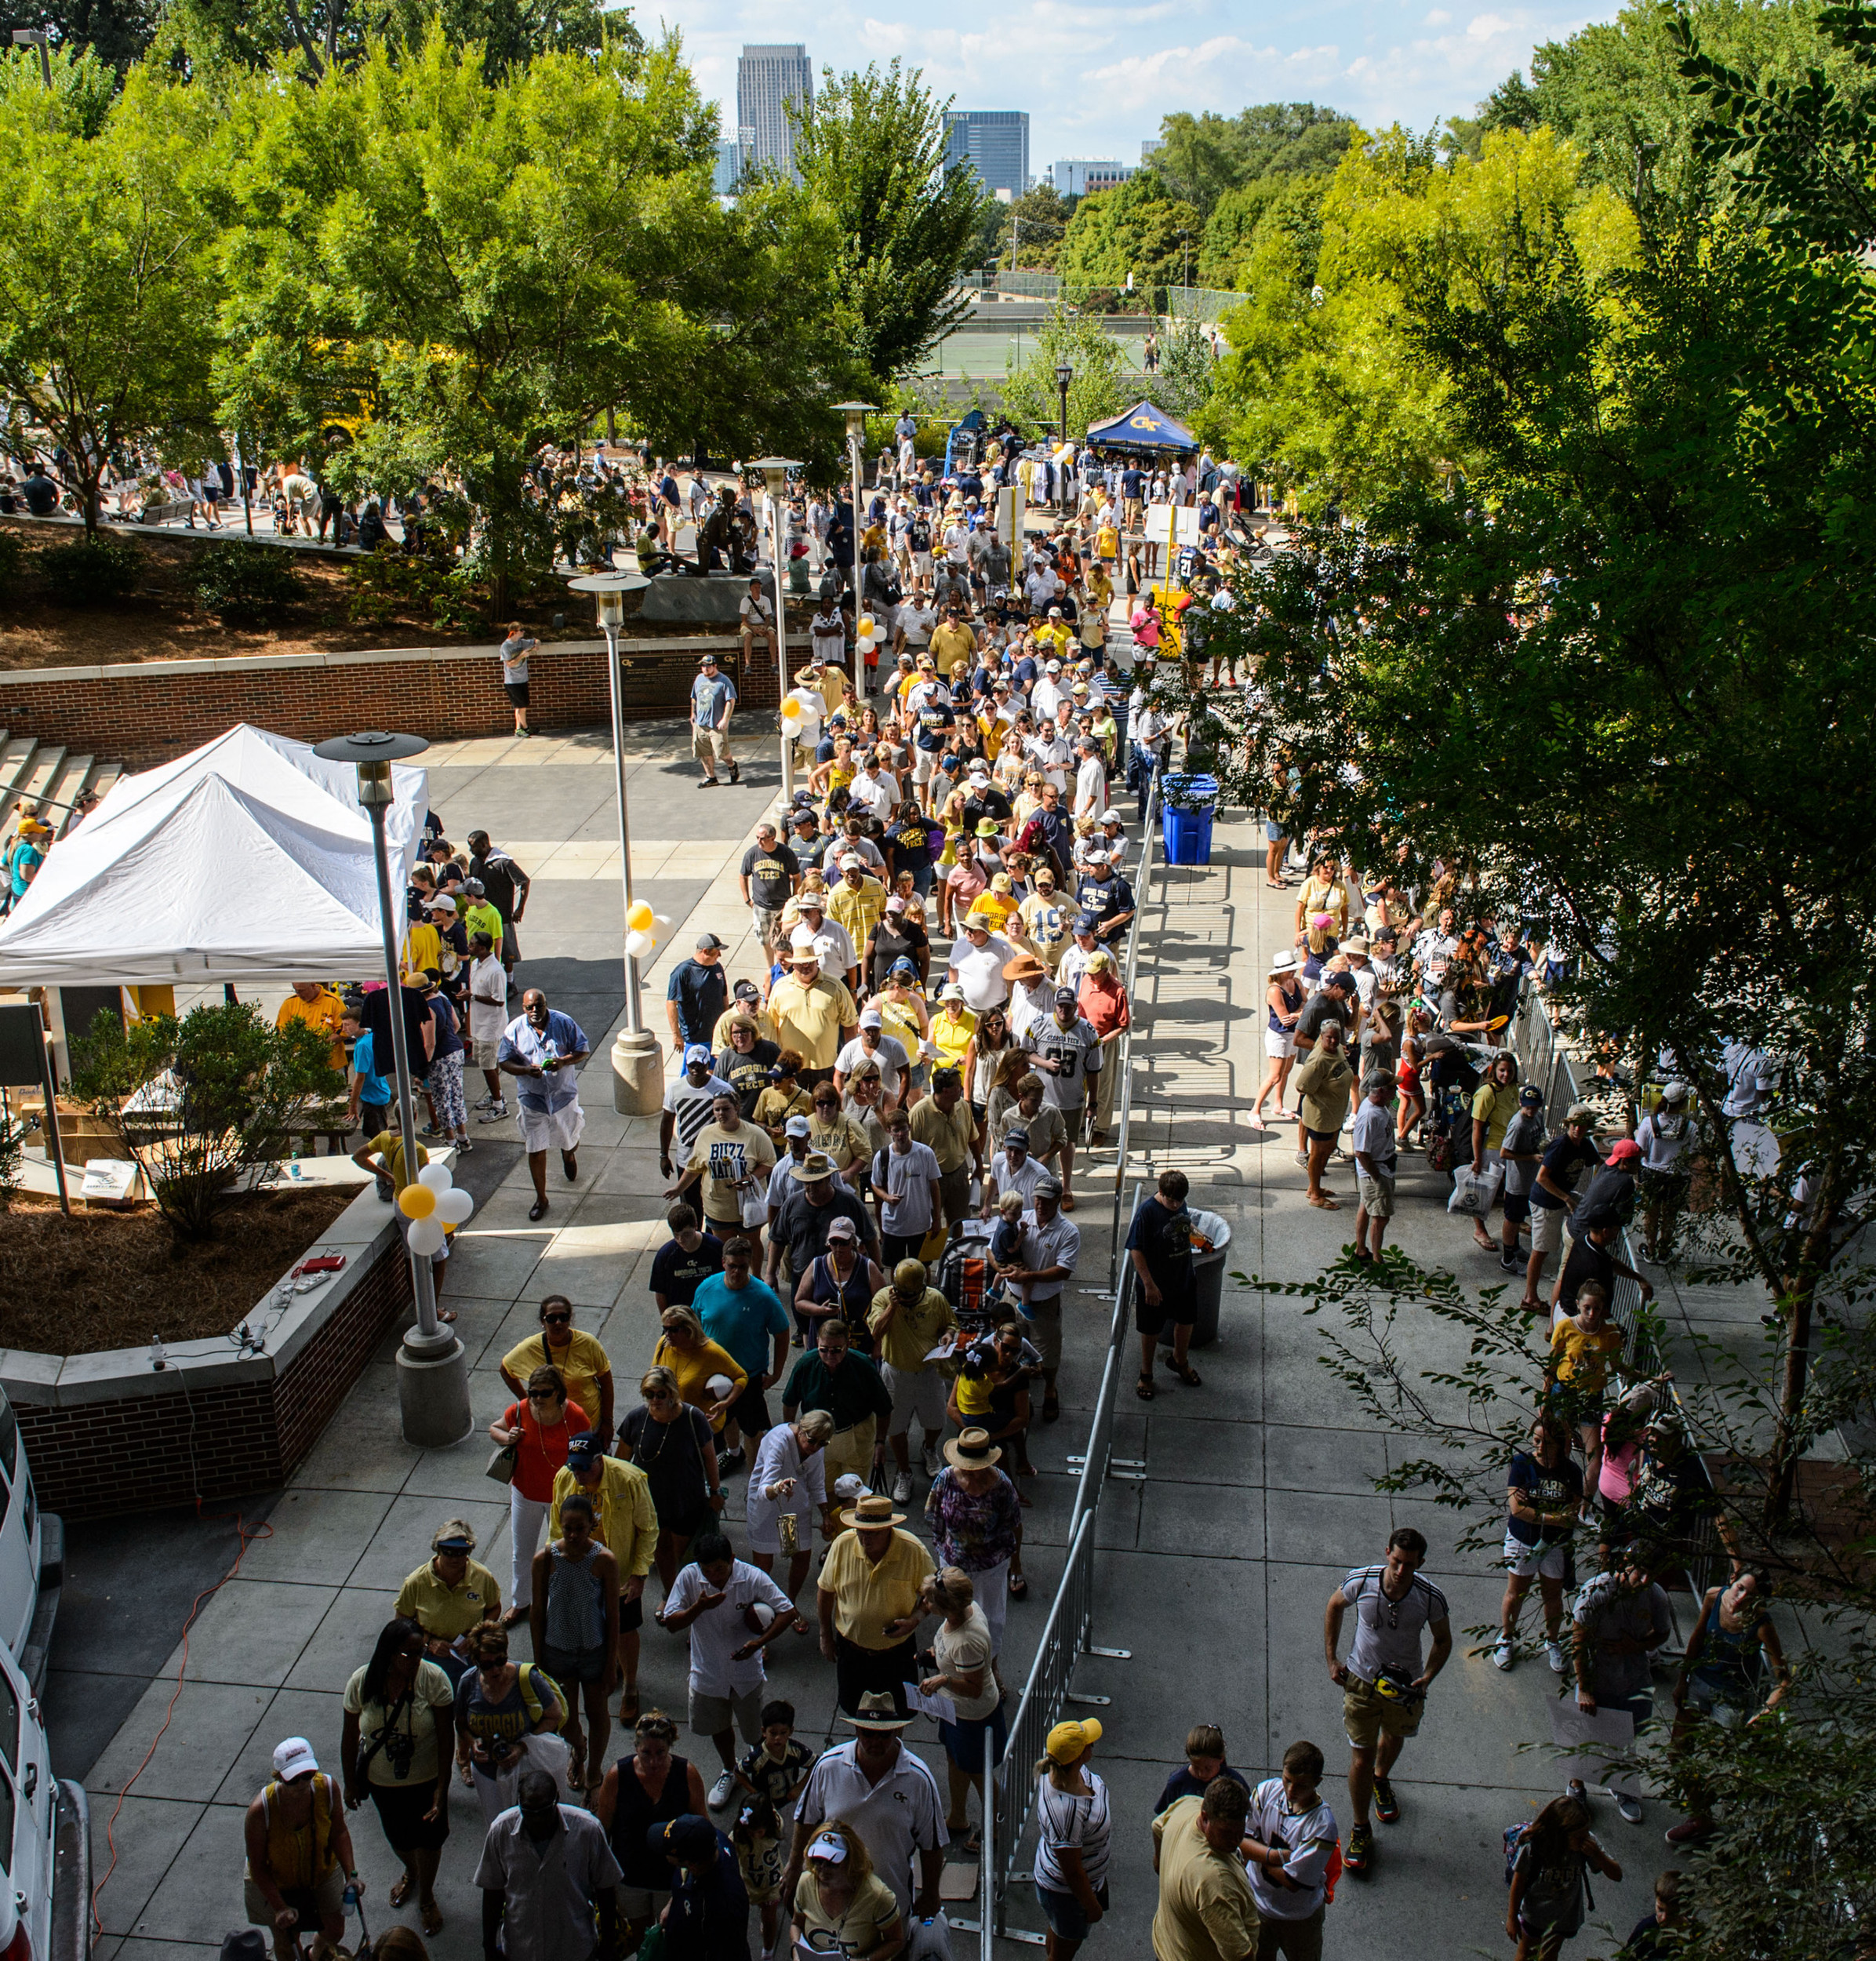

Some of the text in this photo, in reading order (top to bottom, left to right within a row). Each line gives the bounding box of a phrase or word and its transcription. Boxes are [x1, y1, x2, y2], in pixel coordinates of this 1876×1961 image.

[1129, 416, 1162, 431] GT
[1180, 558, 1192, 578] 21
[754, 859, 784, 872] GEORGIA
[759, 871, 780, 880] TECH
[730, 1064, 769, 1080] GEORGIA
[737, 1079, 765, 1091] TECH
[809, 1133, 846, 1148] MOM
[710, 1142, 746, 1162] BUZZ
[708, 1160, 748, 1180] NATIN
[569, 1439, 589, 1450] BUZZ
[893, 1791, 907, 1803] GT
[822, 1833, 836, 1845] GT
